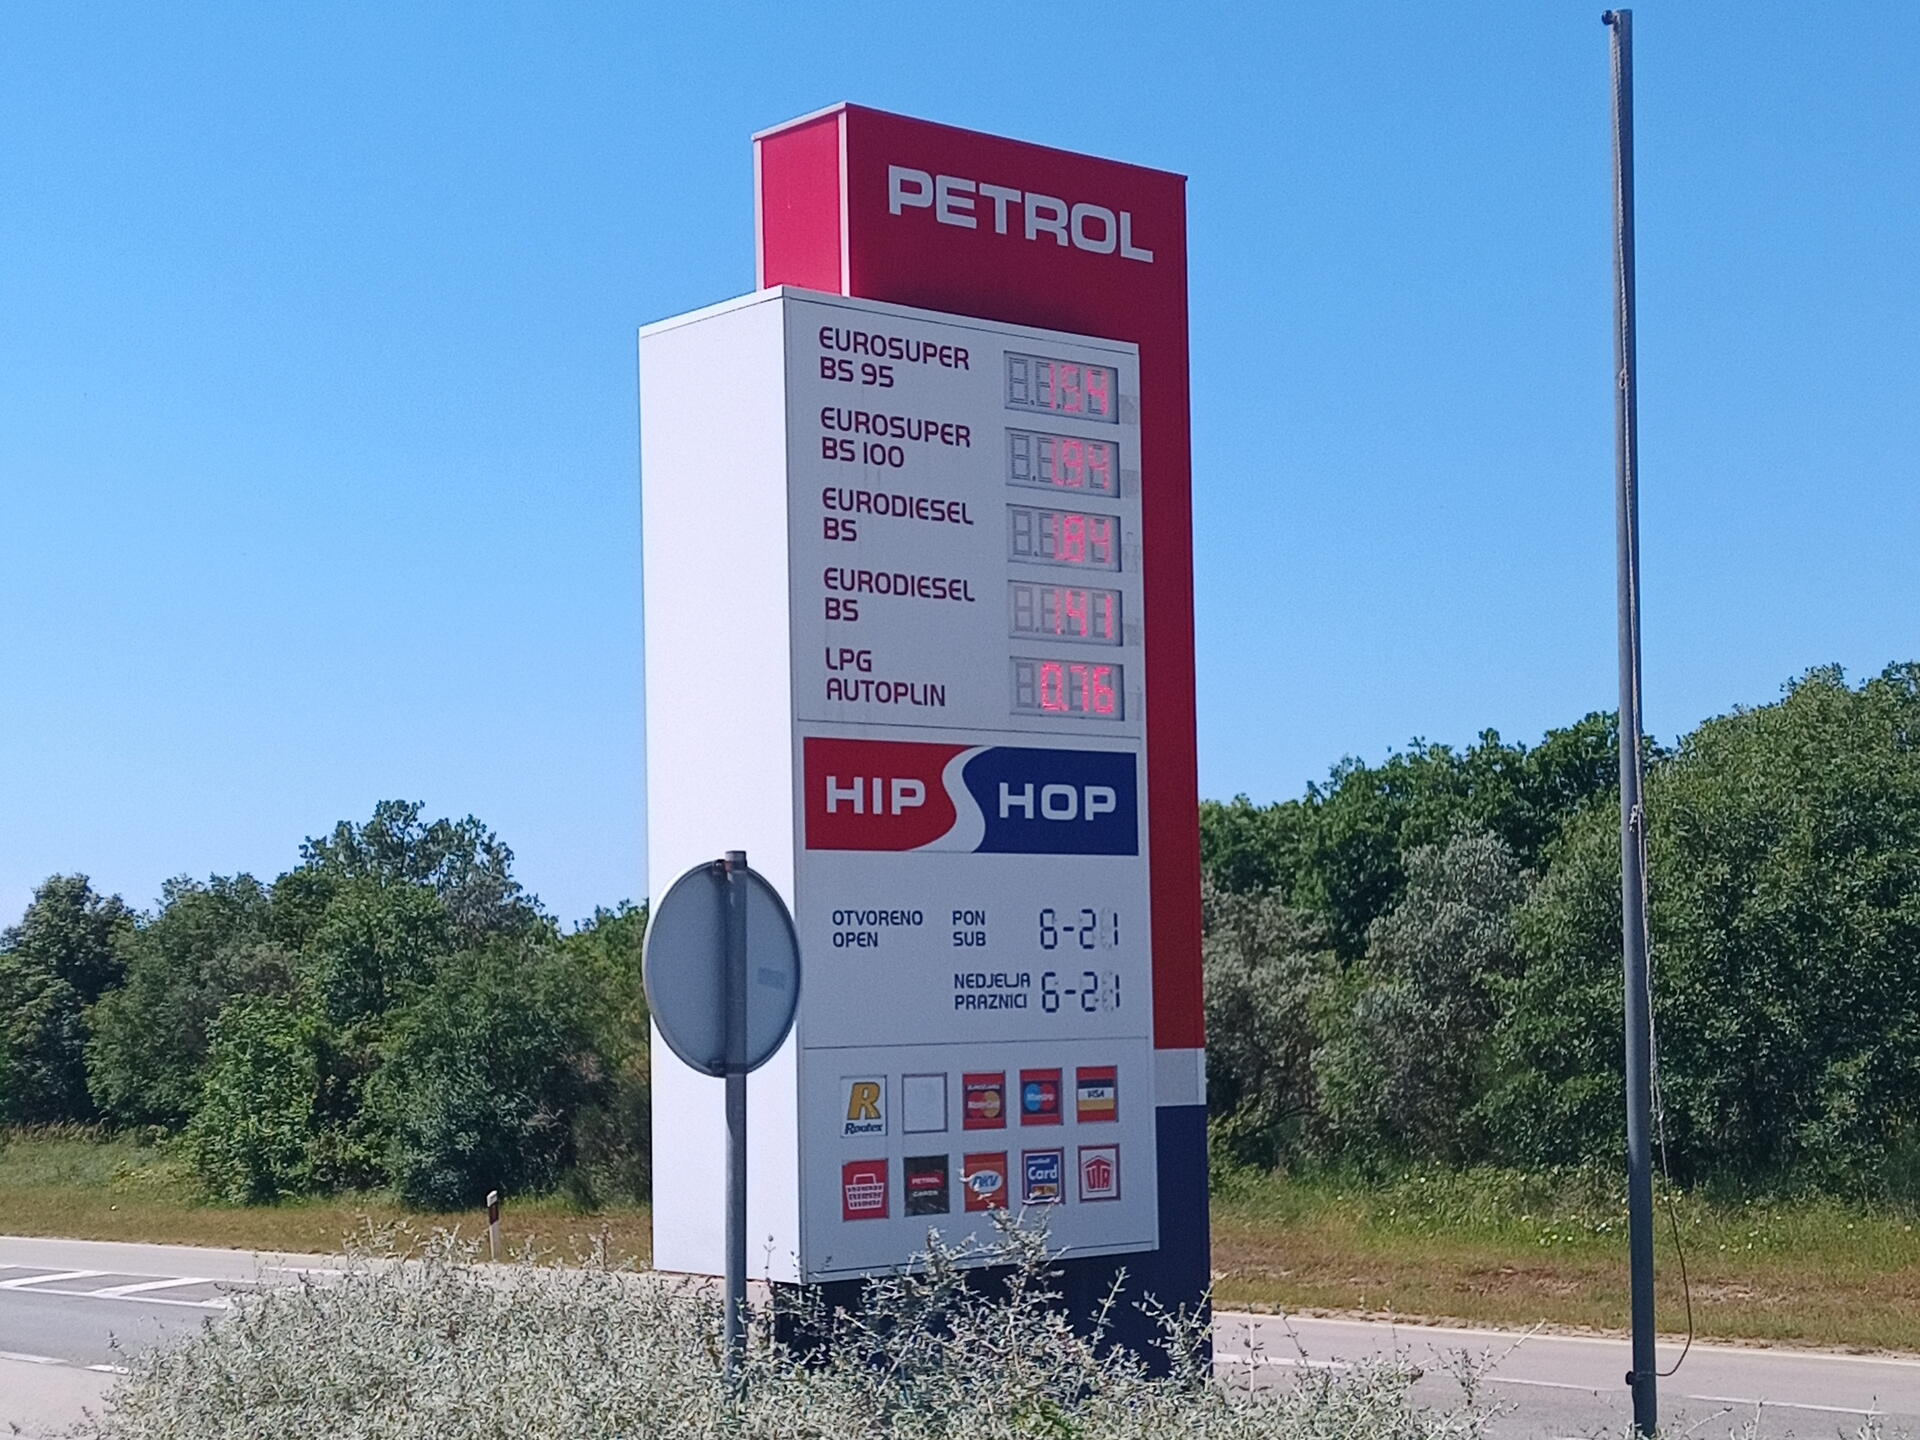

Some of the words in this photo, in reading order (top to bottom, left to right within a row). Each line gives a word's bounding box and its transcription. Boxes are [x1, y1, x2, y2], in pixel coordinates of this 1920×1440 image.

[888, 164, 1154, 264] PETROL
[818, 326, 970, 370] EUROSUPER
[819, 355, 854, 383] BS
[861, 362, 894, 388] 95
[820, 406, 971, 448] EUROSUPER
[821, 436, 856, 463] BS
[863, 443, 905, 468] 100
[822, 487, 975, 526] EURODIESEL
[823, 518, 857, 542] BS
[823, 567, 976, 602] EURODIESEL
[825, 598, 859, 622] BS
[825, 647, 872, 672] LPG
[826, 678, 946, 707] AUTOPLIN
[825, 775, 926, 815] HIP
[832, 909, 924, 927] OTVORENO
[952, 910, 986, 926] PON
[832, 931, 879, 947] OPEN
[952, 931, 987, 947] SUB
[953, 972, 1031, 989] NEDJELJA
[953, 993, 1028, 1010] PRAZNICI
[1028, 1164, 1058, 1180] Card
